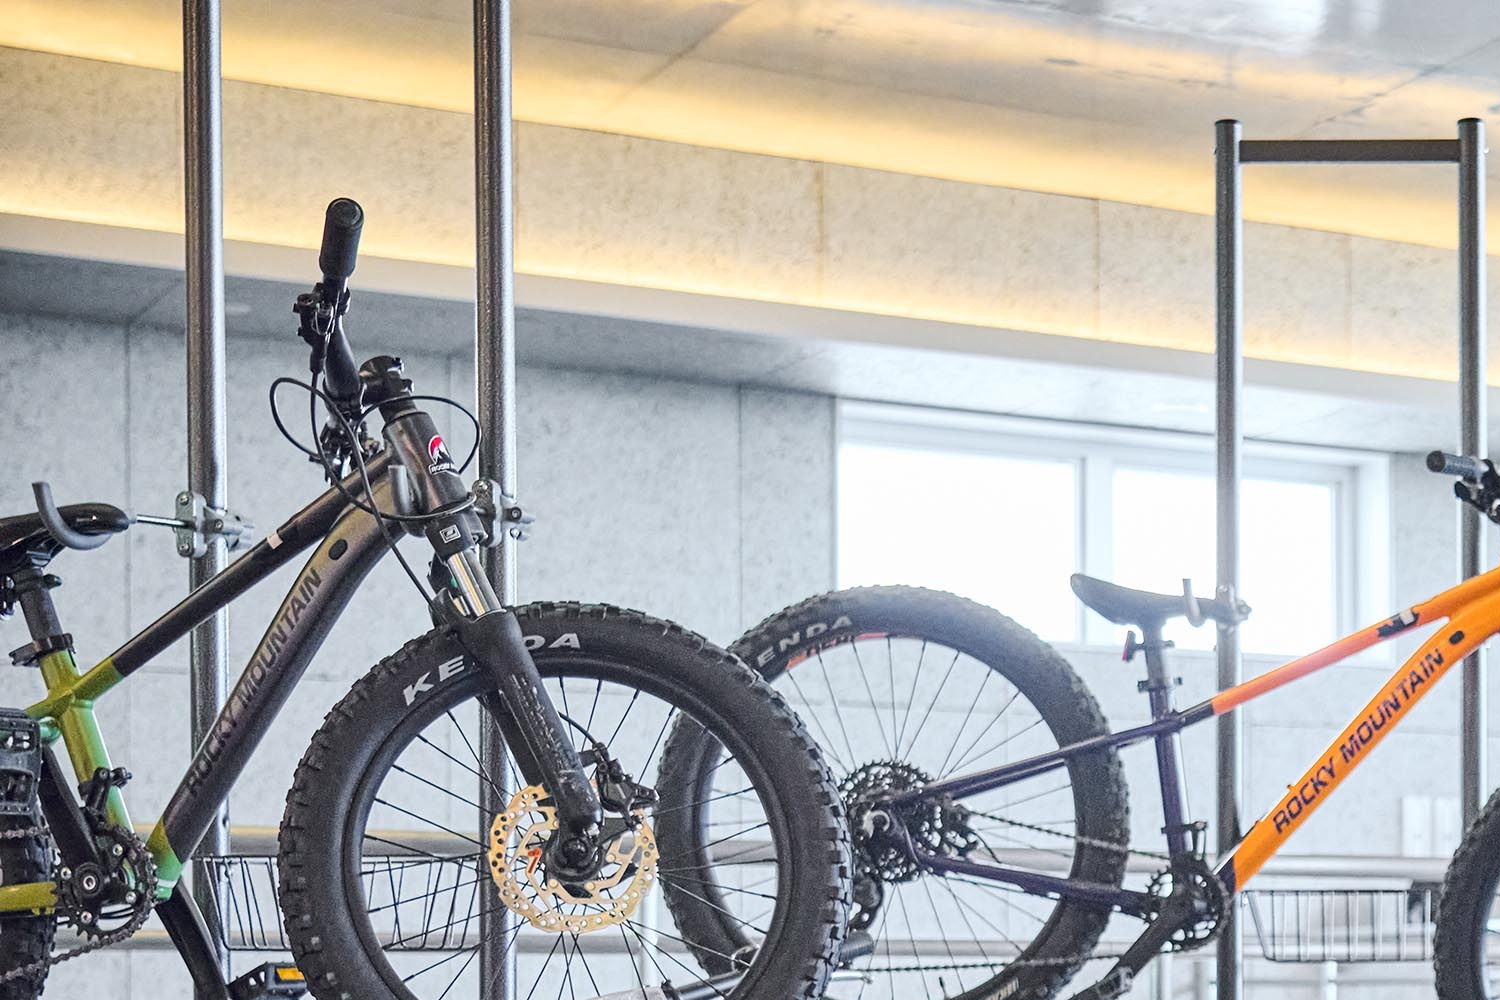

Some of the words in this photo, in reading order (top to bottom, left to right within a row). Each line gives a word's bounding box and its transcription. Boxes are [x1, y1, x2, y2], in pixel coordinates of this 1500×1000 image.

[187, 700, 238, 798] ROCKY
[236, 566, 323, 709] MOUNTAIN
[403, 633, 581, 706] KEDA
[757, 615, 853, 667] ENDA
[1273, 757, 1336, 834] ROCKY
[1339, 648, 1444, 764] MOUNTAIN
